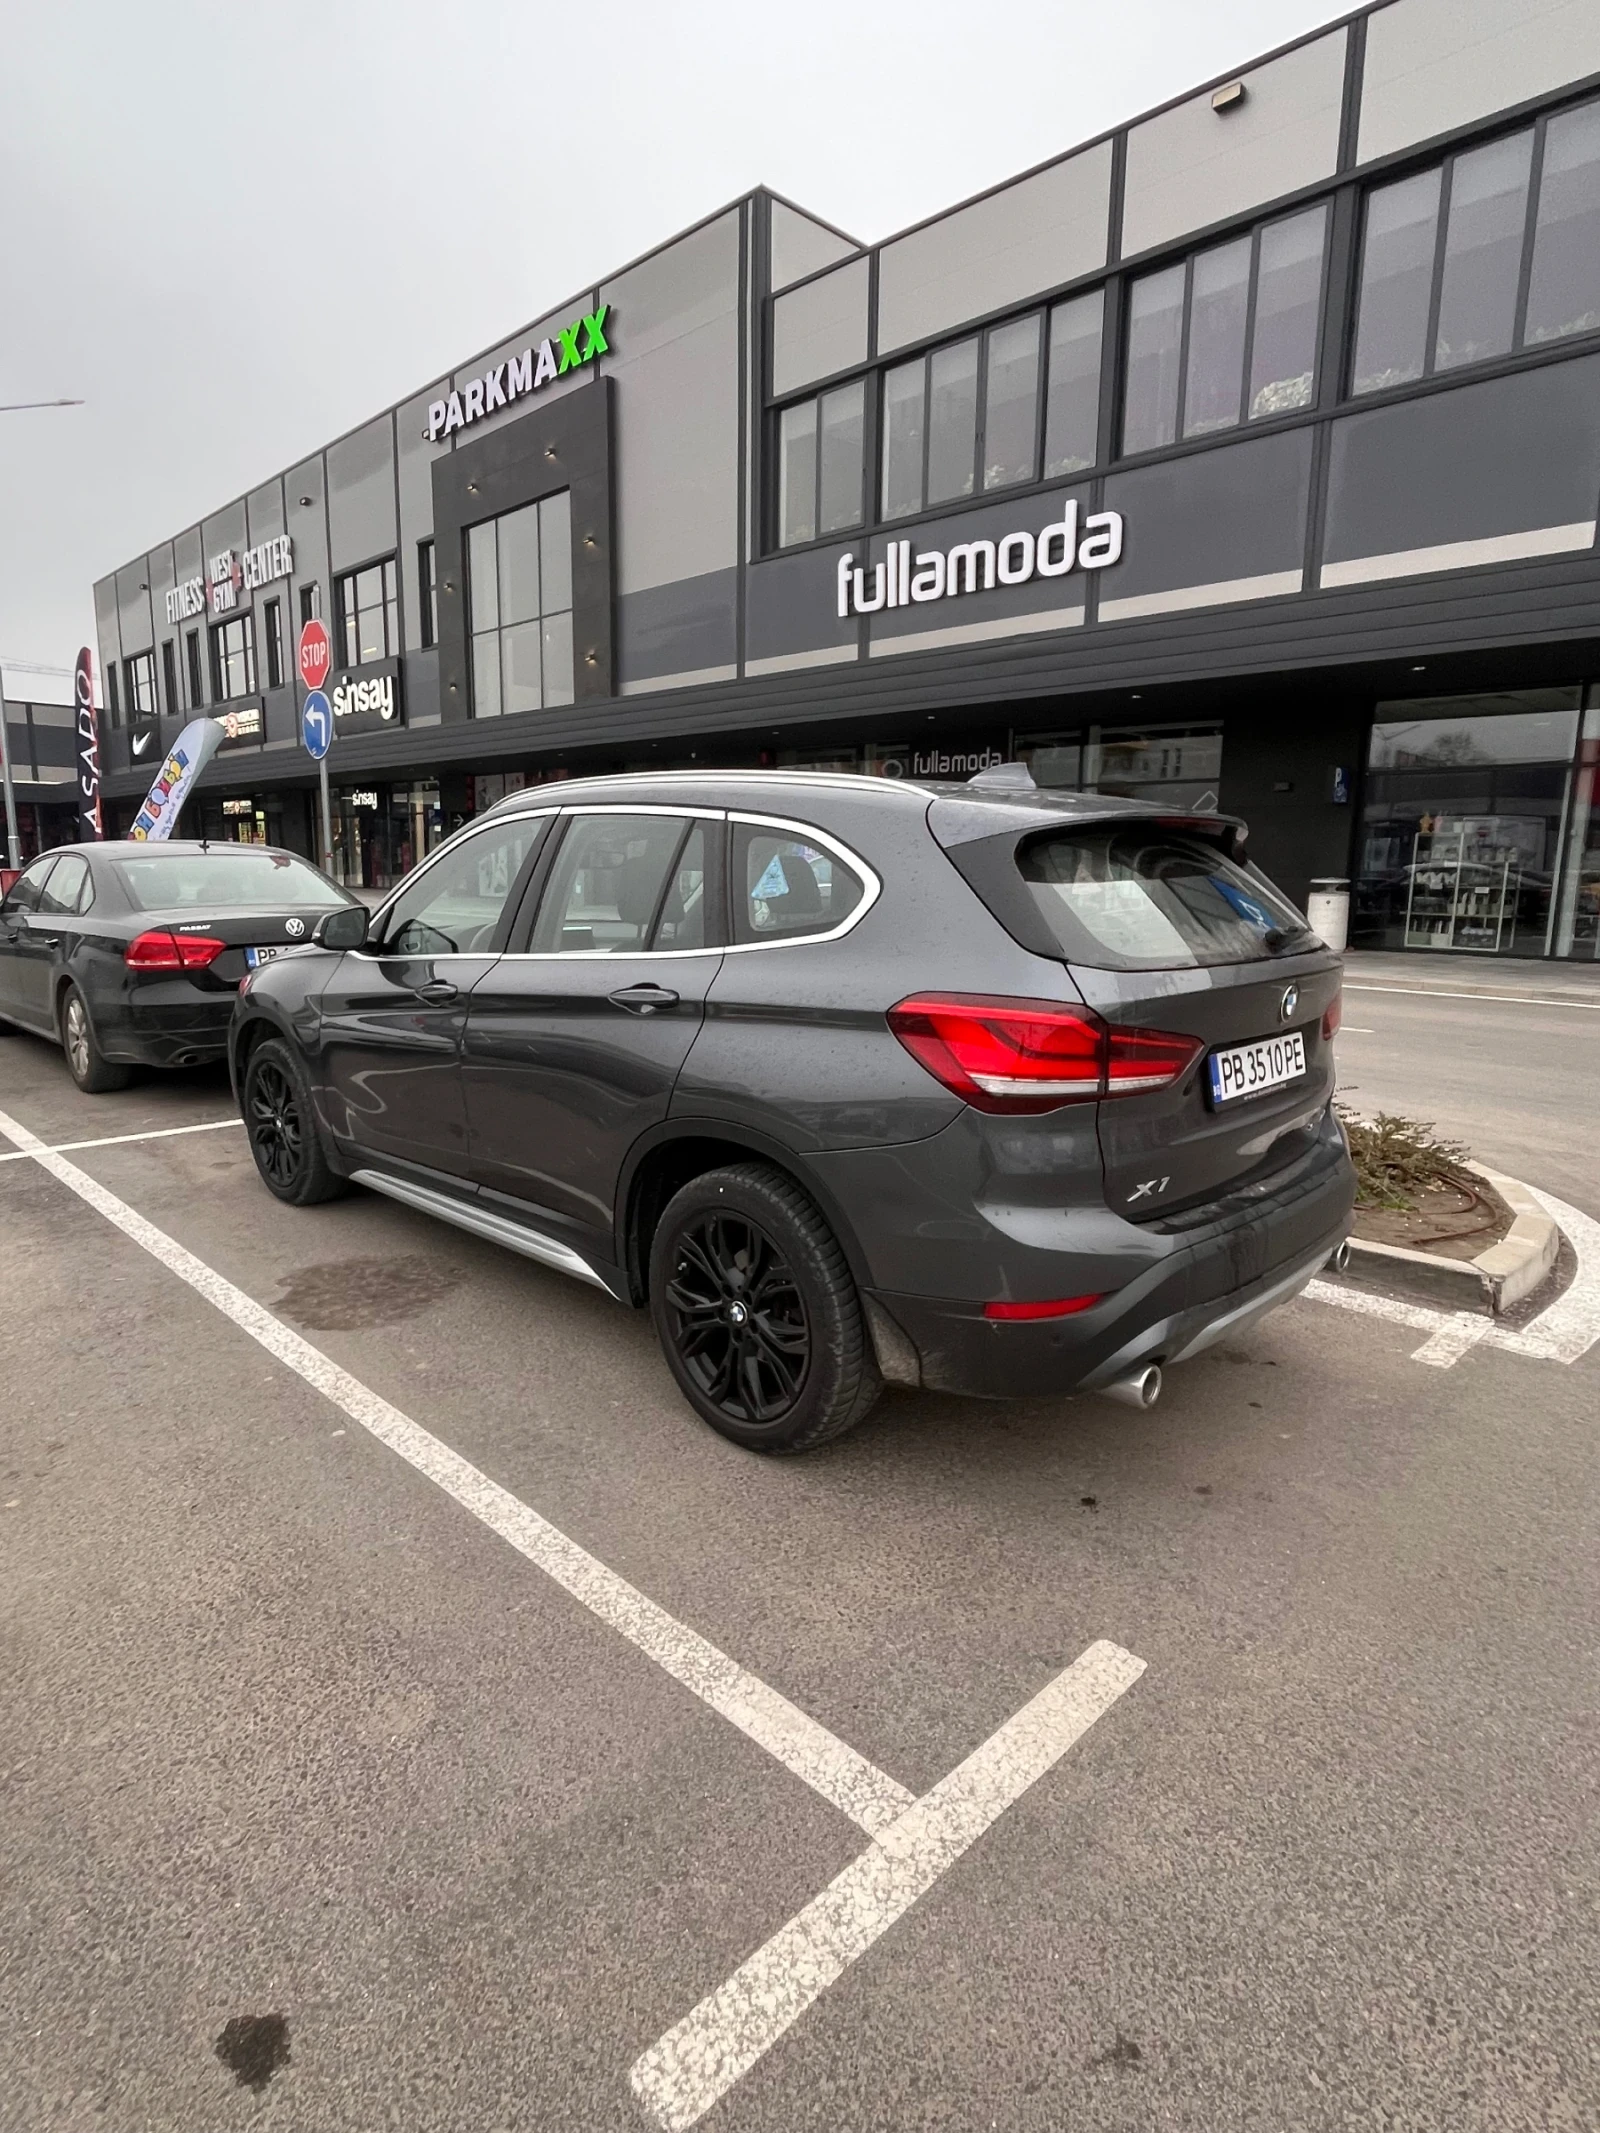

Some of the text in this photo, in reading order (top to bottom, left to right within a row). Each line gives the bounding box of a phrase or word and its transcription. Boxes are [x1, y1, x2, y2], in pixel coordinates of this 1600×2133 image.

[427, 304, 610, 442] PARKMAXX
[209, 549, 235, 584] WEST
[837, 498, 1123, 618] fullamoda
[165, 534, 293, 624] FITNESS CENTER
[212, 579, 238, 613] GYM
[301, 641, 326, 669] STOP
[333, 675, 394, 720] sinsay
[76, 669, 103, 836] ASADO
[913, 746, 1003, 775] fullamoda
[352, 789, 378, 810] sinsay
[1221, 1054, 1245, 1094] PB
[1247, 1043, 1283, 1085] 3510
[1284, 1037, 1304, 1075] PE
[1127, 1176, 1171, 1202] X1
